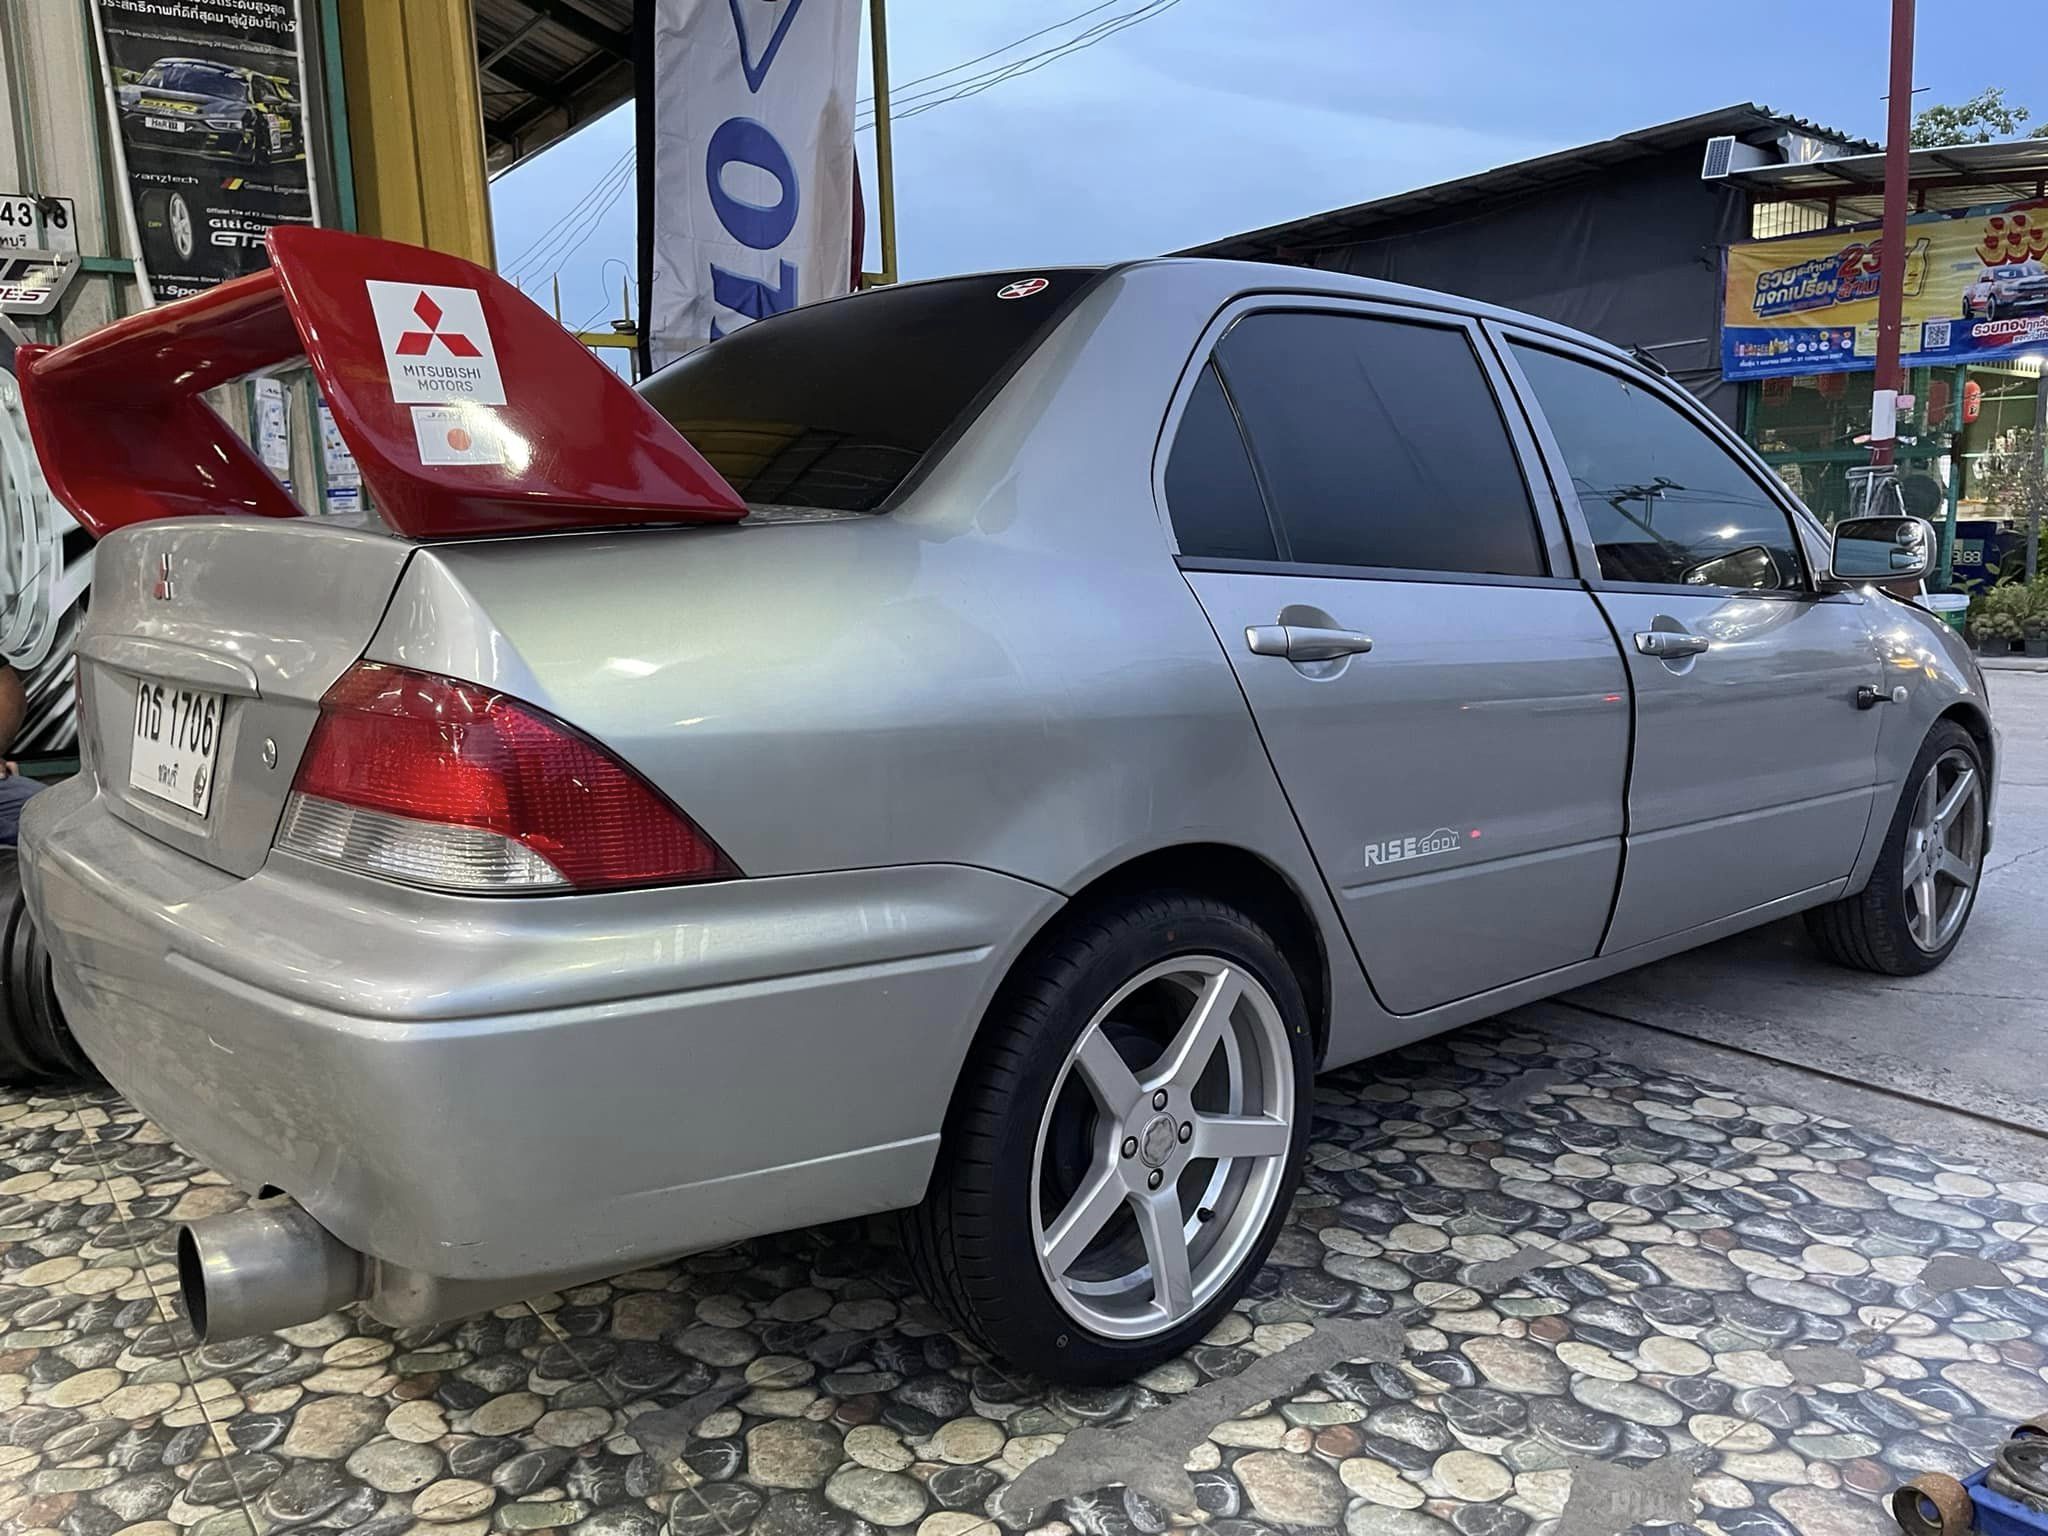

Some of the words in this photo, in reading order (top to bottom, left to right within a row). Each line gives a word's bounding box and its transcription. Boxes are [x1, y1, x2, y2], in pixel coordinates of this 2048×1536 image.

[403, 364, 481, 380] MITSUBISHI
[418, 379, 474, 392] MOTORS
[170, 689, 216, 758] 1706
[1364, 837, 1417, 867] RISE
[1422, 835, 1458, 853] BODY
